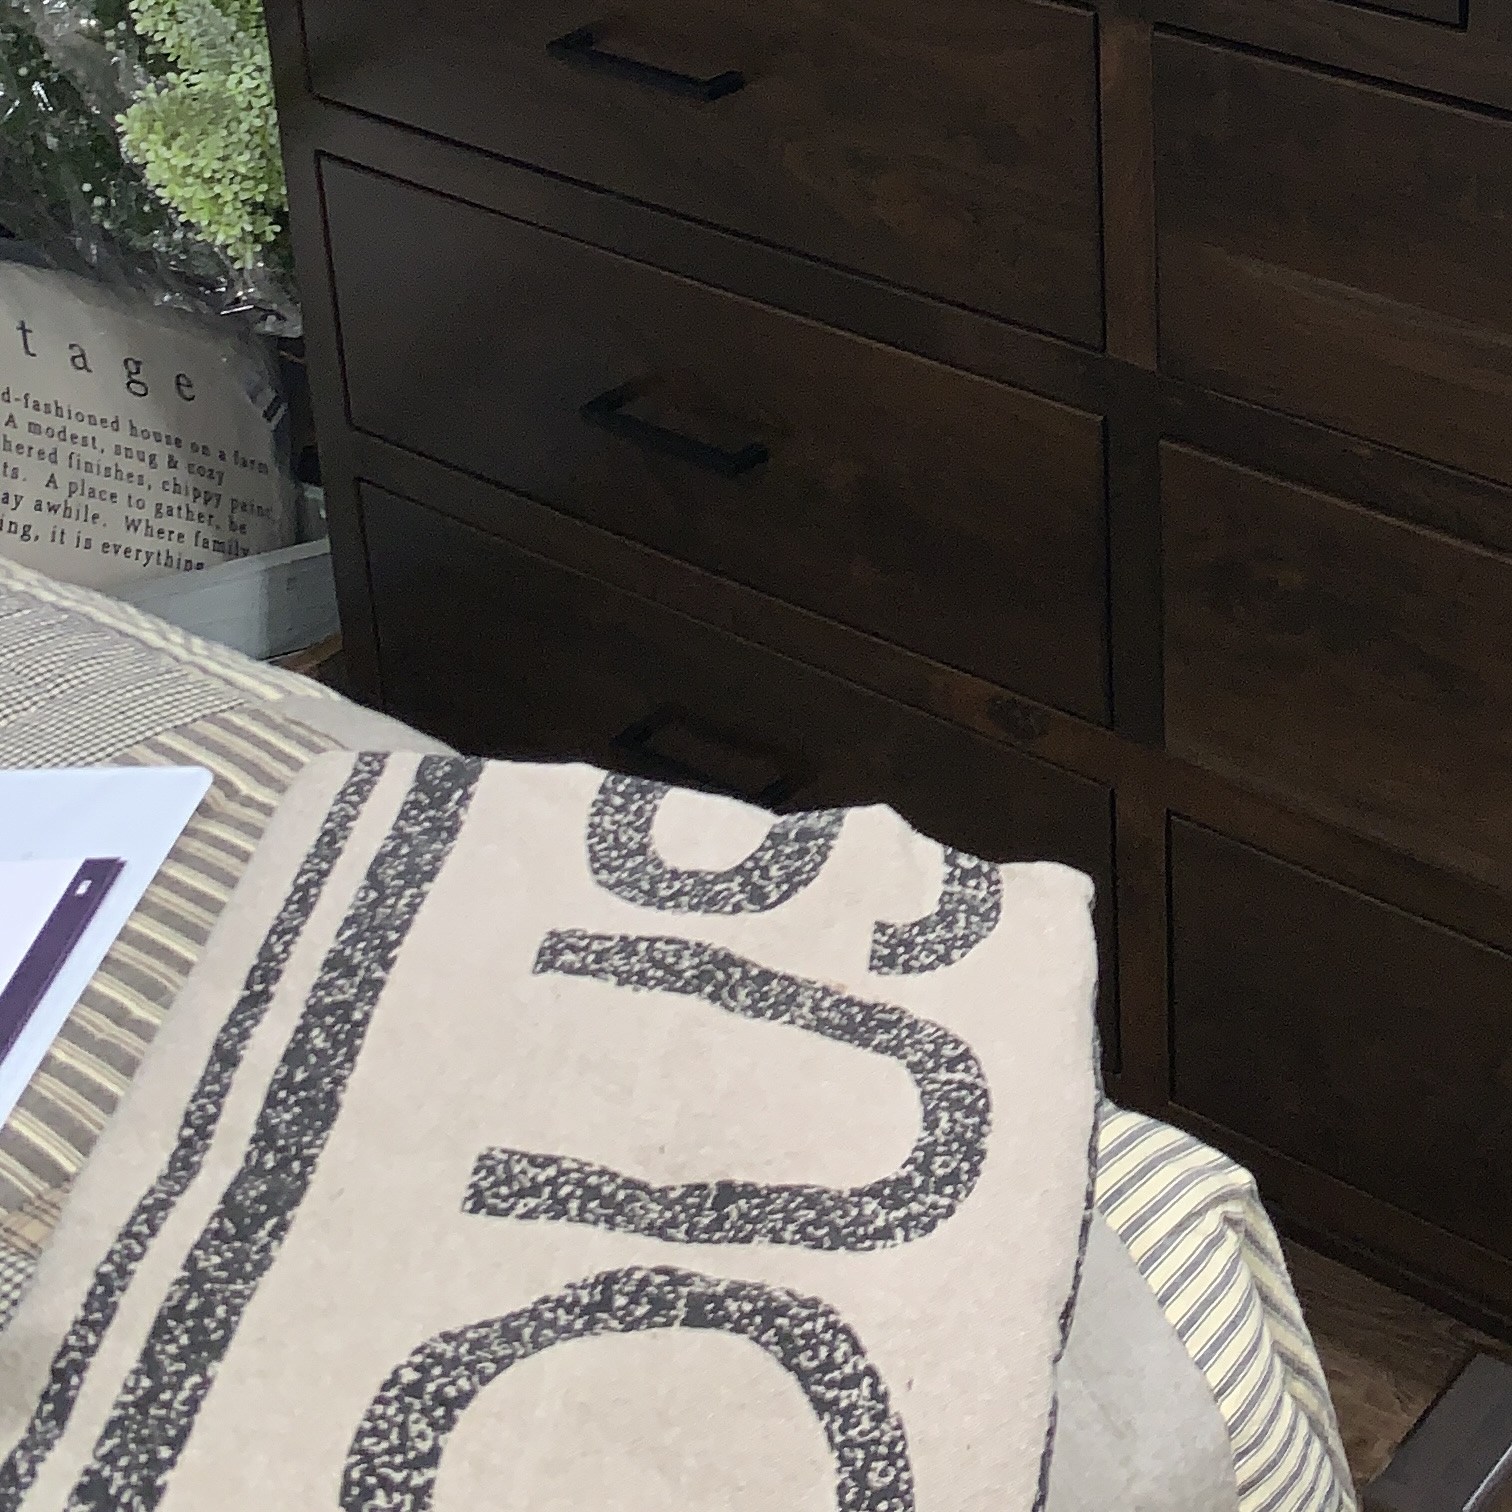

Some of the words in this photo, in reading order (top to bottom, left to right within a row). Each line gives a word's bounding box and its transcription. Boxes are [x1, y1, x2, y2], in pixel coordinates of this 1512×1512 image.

[4, 413, 18, 429] A
[27, 420, 105, 455] modest,
[114, 443, 158, 470] snug
[129, 419, 183, 449] house
[45, 472, 59, 490] A
[68, 479, 118, 504] place
[127, 492, 146, 510] to
[68, 451, 152, 491] finishes,
[161, 477, 222, 509] chippy
[33, 496, 107, 528] awhile.
[125, 515, 185, 544] Where
[50, 525, 65, 546] it
[76, 530, 92, 550] is
